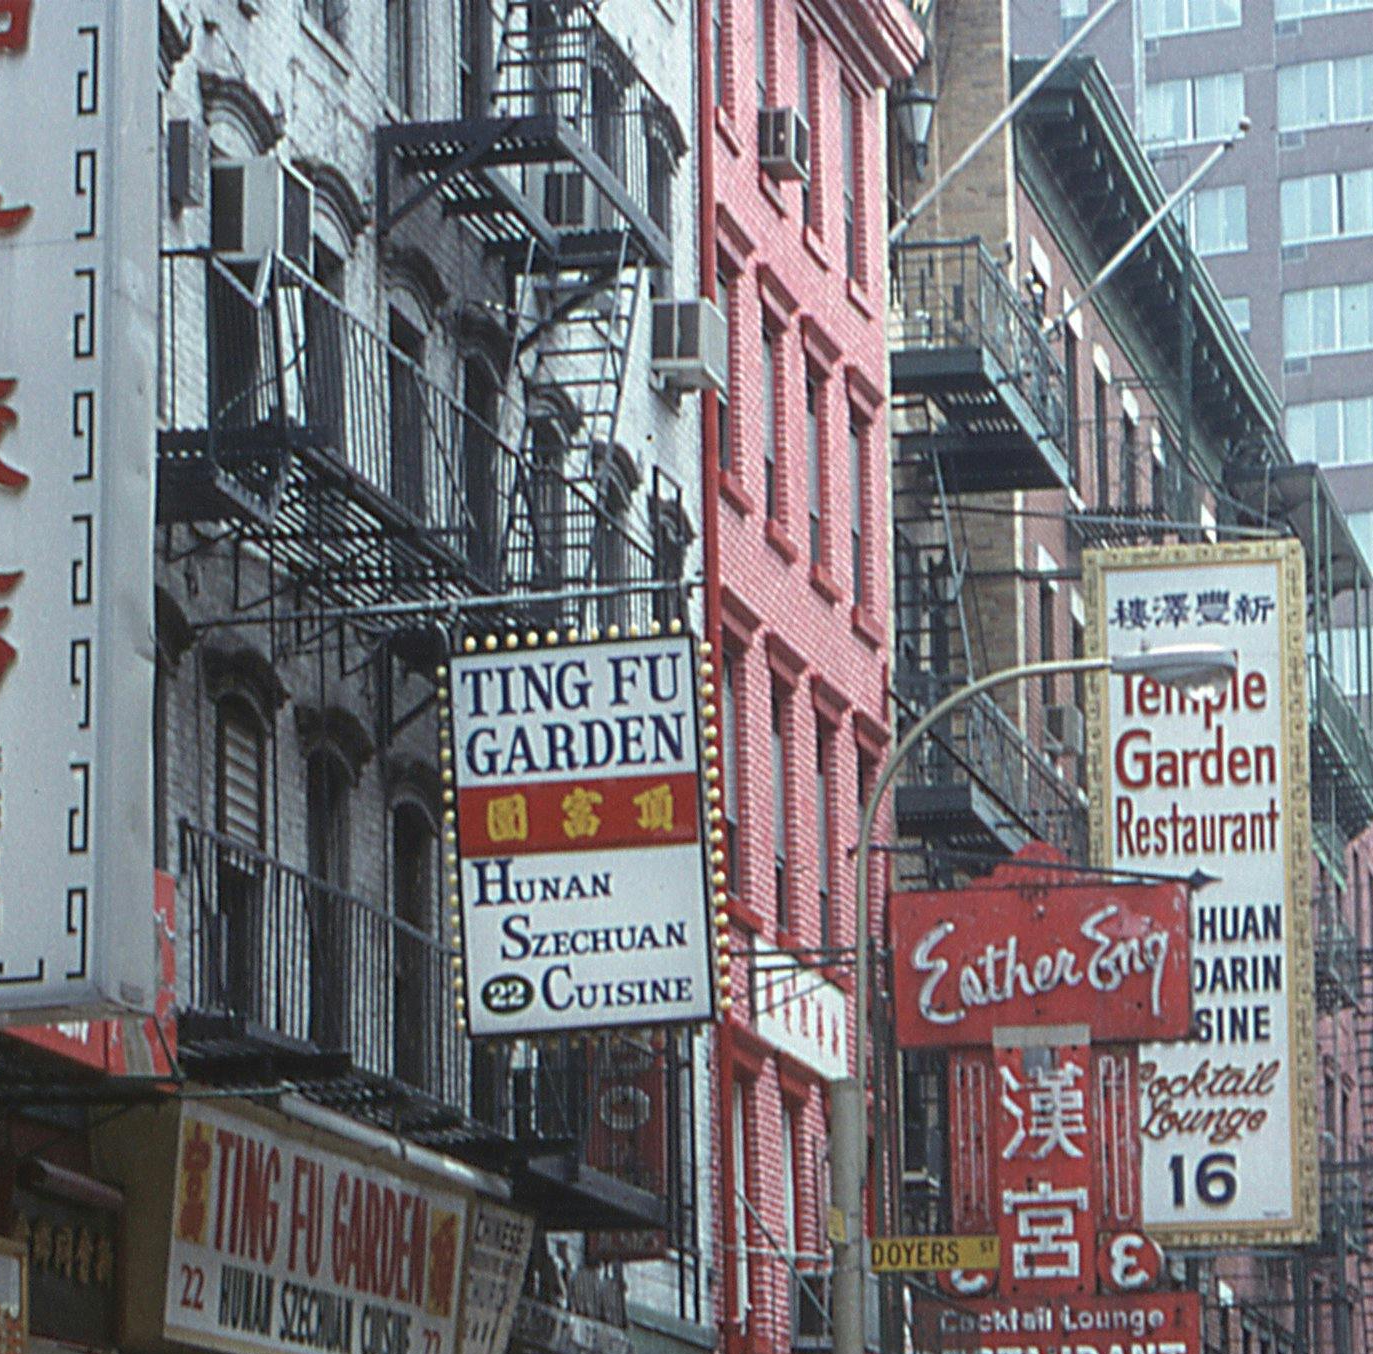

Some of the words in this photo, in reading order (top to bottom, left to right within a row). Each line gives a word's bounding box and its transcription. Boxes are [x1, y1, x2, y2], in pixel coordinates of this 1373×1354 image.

[461, 660, 592, 718] TING
[608, 652, 683, 707] FU
[465, 712, 688, 778] GARDEN
[1115, 724, 1277, 790] Garden
[1116, 797, 1280, 858] Restaurant
[500, 914, 687, 960] SZECHUAN
[1199, 905, 1283, 943] HUAN
[1080, 904, 1170, 1017] Eng
[1194, 954, 1283, 994] DARIN
[489, 981, 528, 1008] 22
[540, 963, 694, 1012] CUISINE
[1195, 1005, 1271, 1044] SINE
[1141, 1100, 1268, 1145] Lounge
[1000, 1061, 1089, 1278] 漢宮
[1168, 1152, 1238, 1209] 16
[214, 1127, 281, 1266] TING
[288, 1155, 325, 1278] FU
[332, 1170, 430, 1308] GARDEN
[871, 1241, 959, 1266] DOYERS
[981, 1241, 995, 1254] ST
[180, 1264, 204, 1311] 22
[219, 1263, 276, 1338] HUNAN
[940, 1306, 1052, 1334] Cocktail
[1064, 1306, 1165, 1336] Lounge
